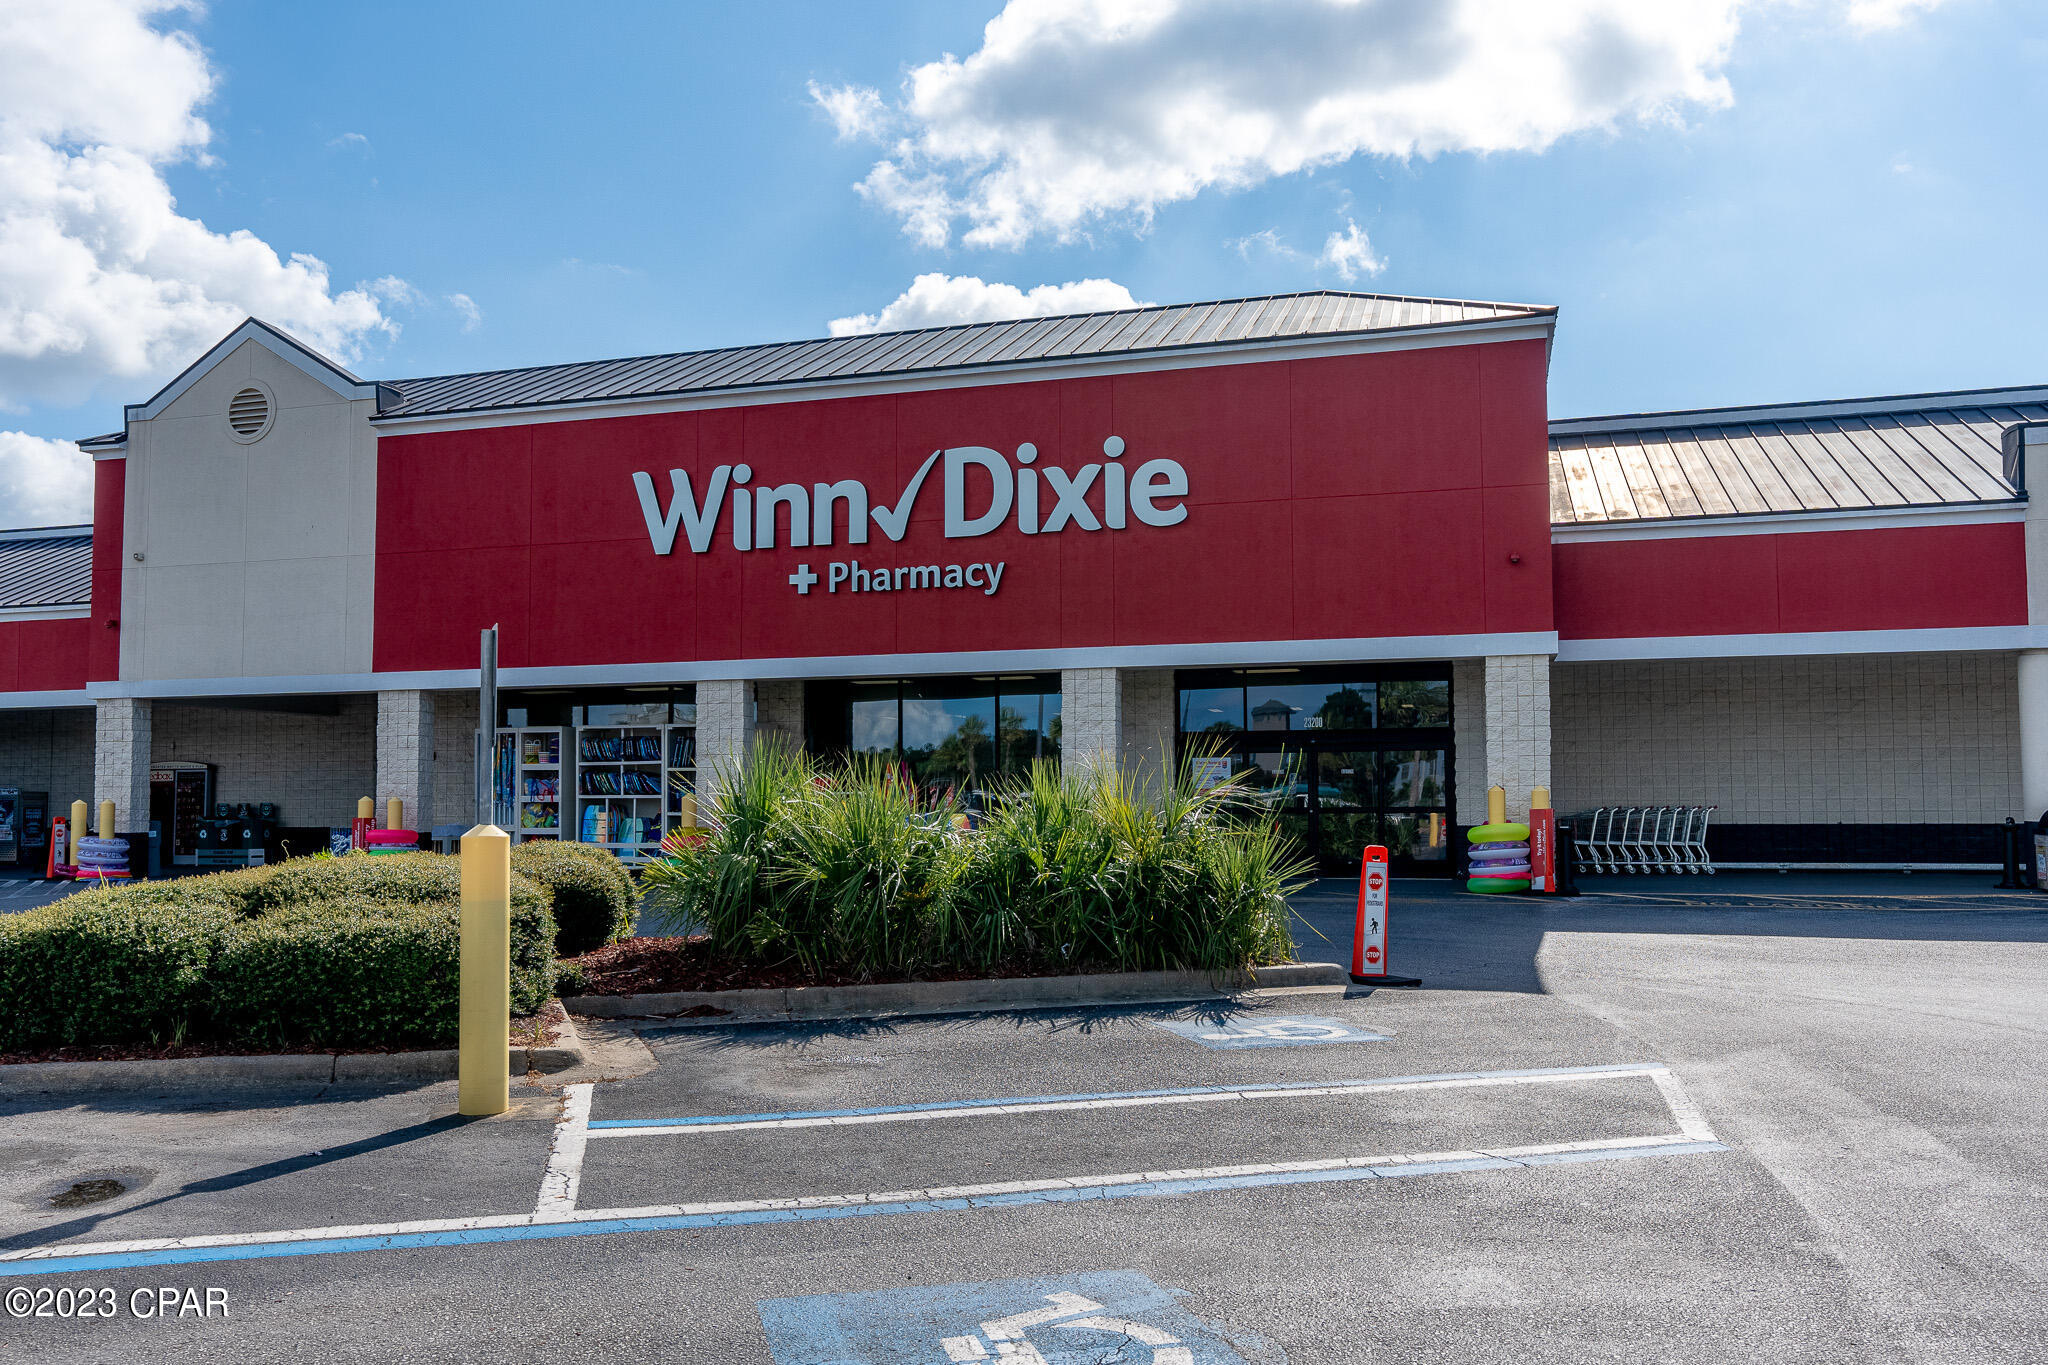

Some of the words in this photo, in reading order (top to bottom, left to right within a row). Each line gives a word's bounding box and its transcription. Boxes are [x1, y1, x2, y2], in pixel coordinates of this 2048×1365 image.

[632, 463, 868, 555] Winn
[944, 436, 1189, 539] Dixie
[828, 560, 1005, 596] Pharmacy
[1304, 716, 1323, 728] 23200
